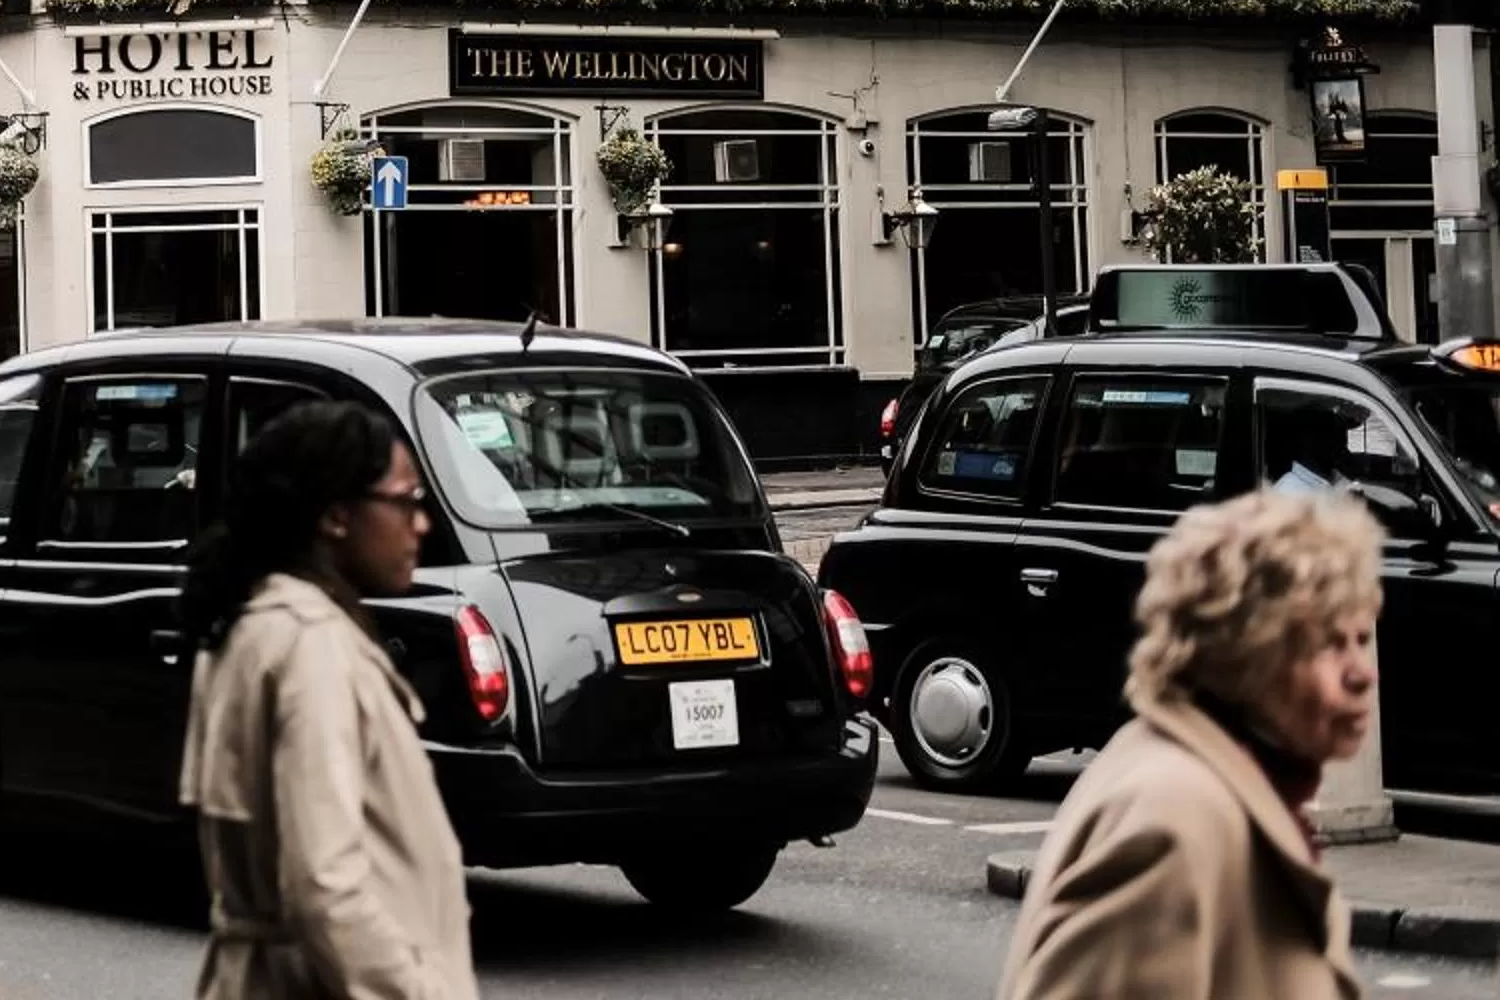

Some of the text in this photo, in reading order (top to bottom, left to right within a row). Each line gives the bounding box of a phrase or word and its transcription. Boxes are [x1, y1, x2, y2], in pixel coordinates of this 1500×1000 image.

[72, 29, 274, 75] HOTEL
[467, 47, 749, 82] THE WELLINGTON
[73, 75, 273, 100] & PUBLIC HOUSE
[626, 621, 746, 655] LC07 YBL
[685, 704, 725, 724] 15007
